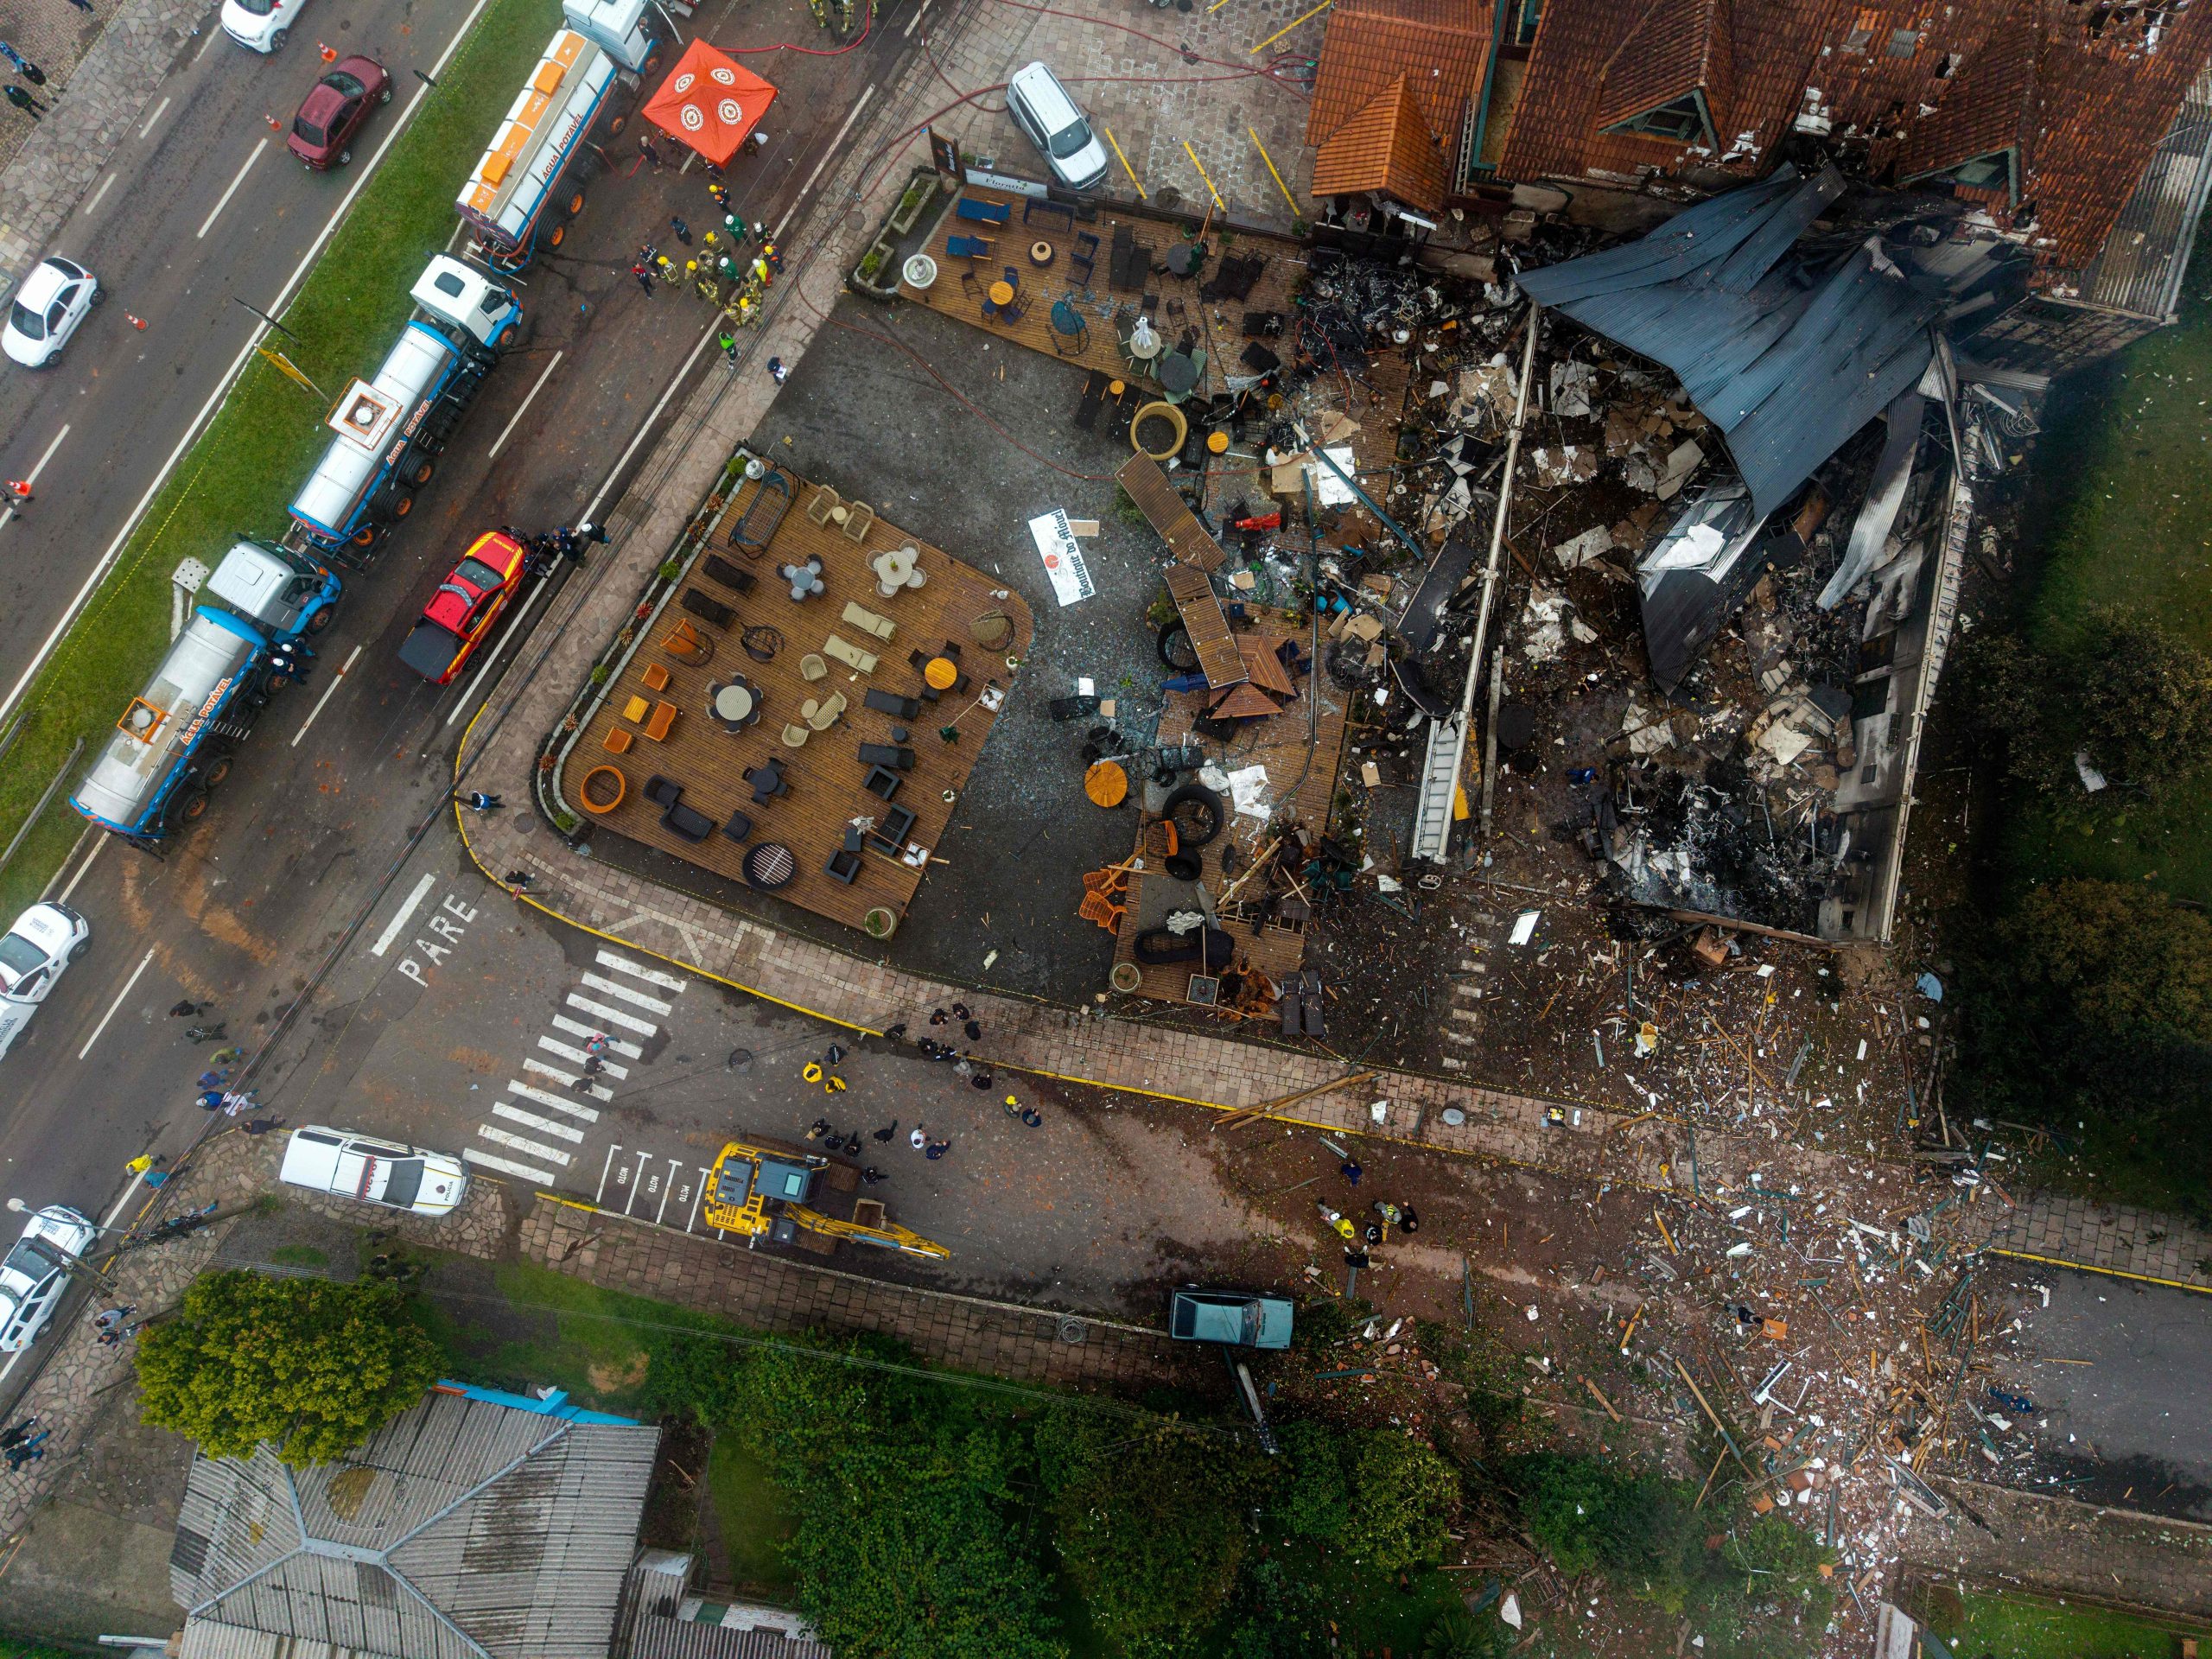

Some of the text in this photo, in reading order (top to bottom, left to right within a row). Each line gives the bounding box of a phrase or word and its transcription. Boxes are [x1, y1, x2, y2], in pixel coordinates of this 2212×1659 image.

[542, 113, 584, 180] ÁGUA POTÁVEL
[386, 399, 431, 466] ÁGUA POTÁVEL
[1065, 542, 1077, 555] do
[1070, 555, 1093, 599] Boutique
[180, 677, 232, 746] ÁGUA POTÁVEL
[397, 893, 479, 988] PARE
[617, 1166, 629, 1185] MOTO
[648, 1175, 659, 1193] MOTO
[678, 1185, 690, 1203] MOTO
